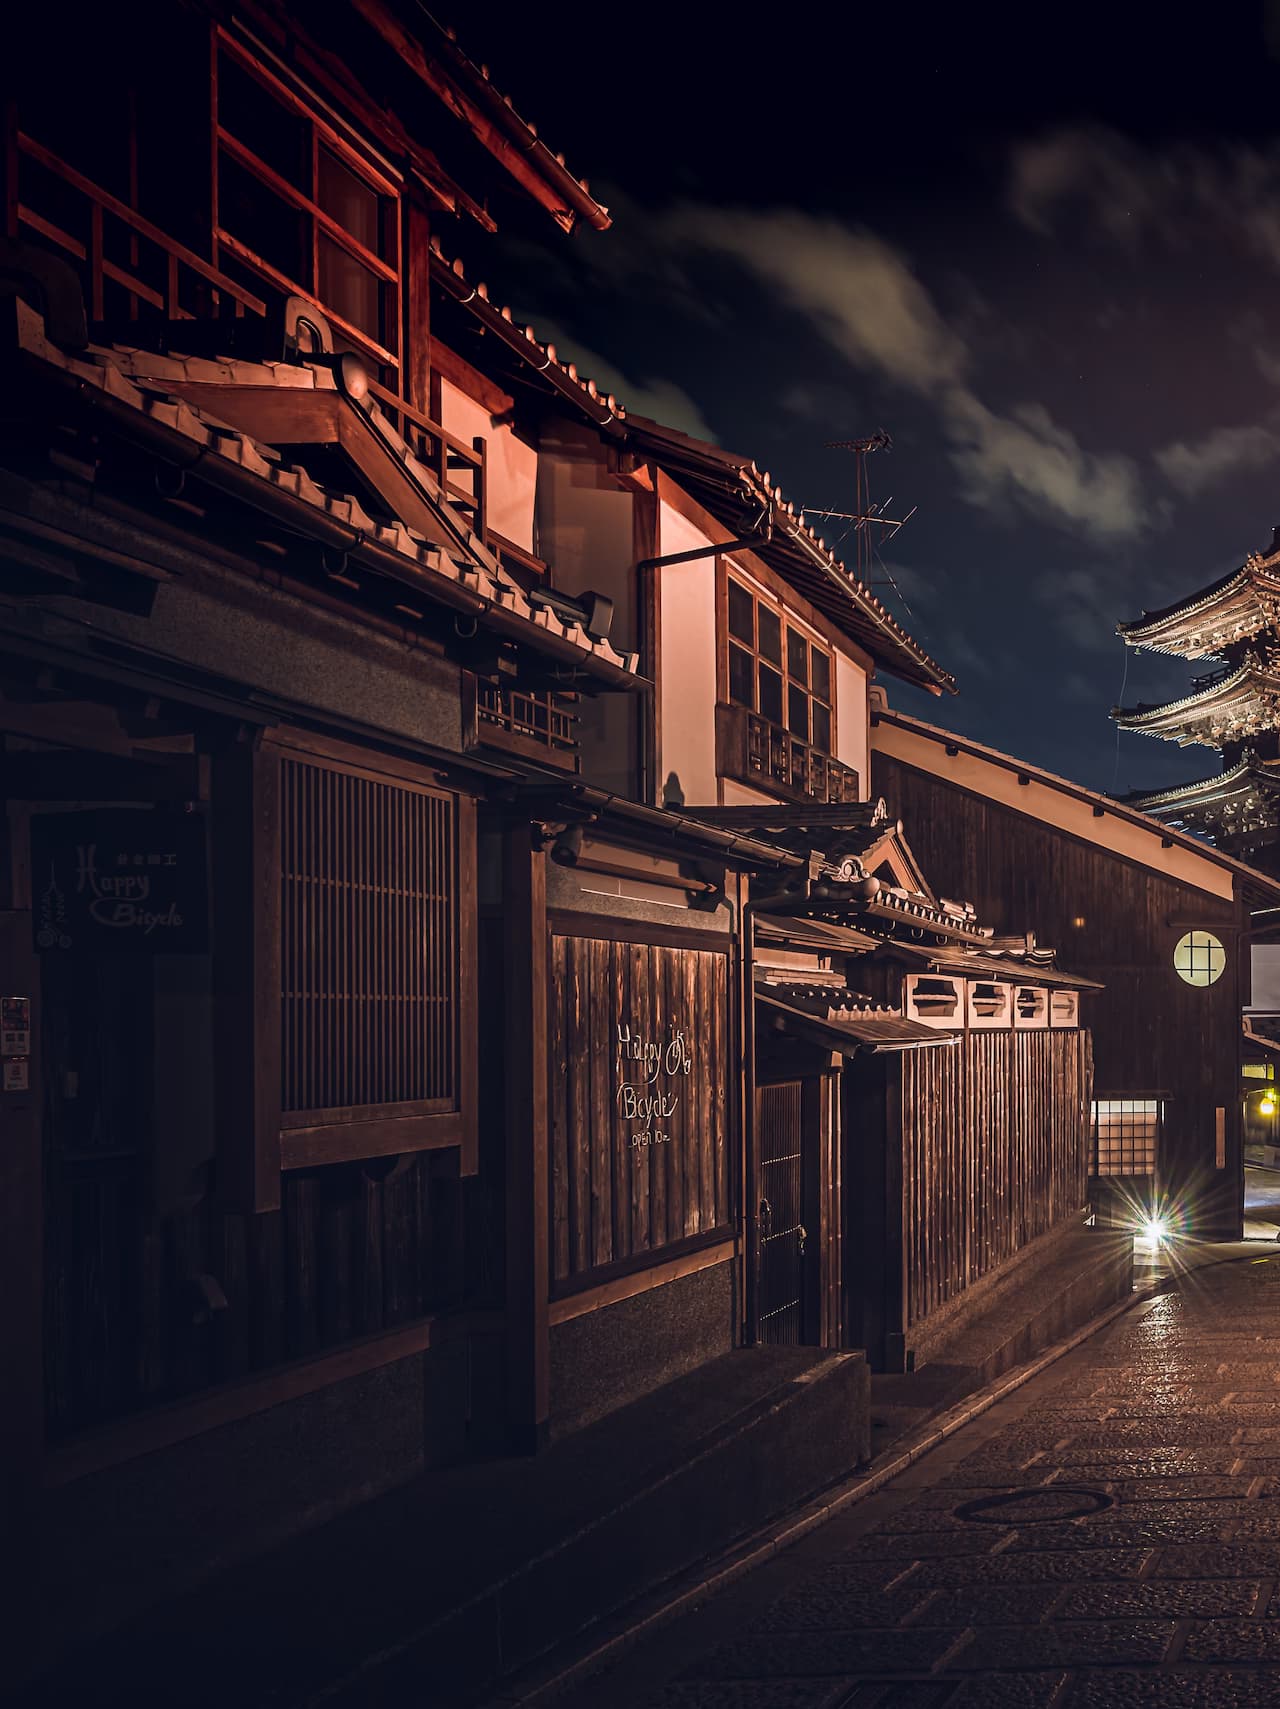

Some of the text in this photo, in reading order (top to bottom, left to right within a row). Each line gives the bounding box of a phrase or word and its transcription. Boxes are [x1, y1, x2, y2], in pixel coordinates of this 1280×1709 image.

[73, 843, 151, 900] Happy
[108, 901, 185, 935] Bicycle
[617, 1023, 662, 1084] Happy
[623, 1086, 680, 1129] Bicycle
